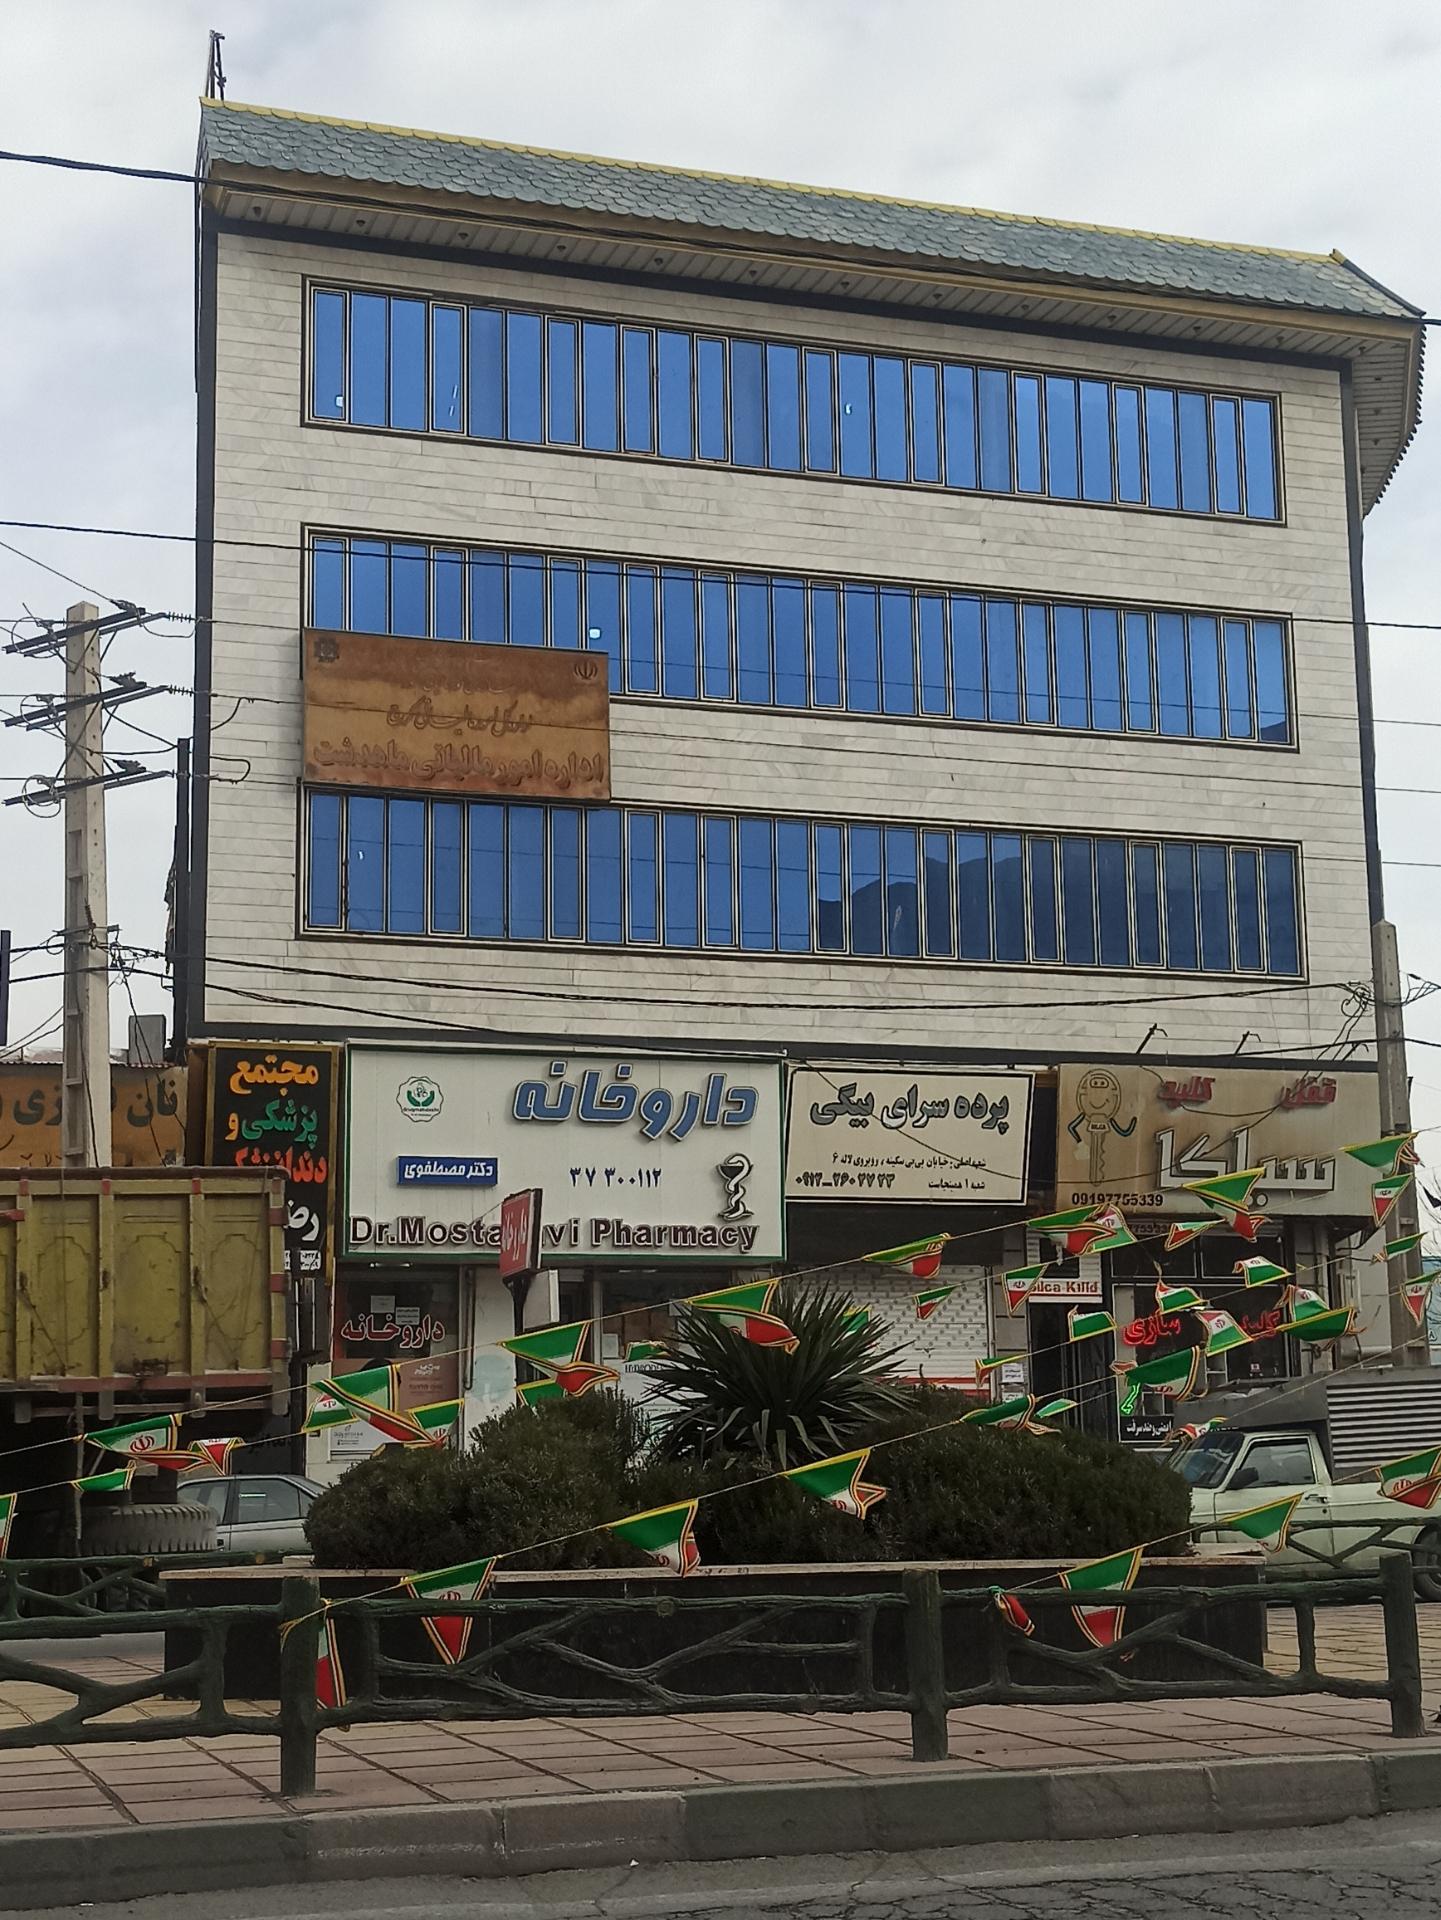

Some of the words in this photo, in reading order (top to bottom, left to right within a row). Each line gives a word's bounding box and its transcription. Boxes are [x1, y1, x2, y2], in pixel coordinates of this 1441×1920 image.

[229, 1054, 319, 1097] مجتمع
[1157, 1076, 1216, 1109] کلید
[513, 1060, 760, 1141] داروخانه
[880, 1083, 950, 1129] سرای
[1279, 1077, 1337, 1110] قفل
[224, 1112, 239, 1141] و
[241, 1099, 318, 1149] پزشکی
[954, 1092, 1010, 1135] پرده
[404, 1160, 466, 1179] مصطفوی
[466, 1162, 494, 1179] دکتر
[927, 1156, 948, 1169] خیابان
[349, 1216, 581, 1247] Dr.Mostavi
[591, 1218, 759, 1253] Pharmacy
[341, 1313, 446, 1348] داروخانه
